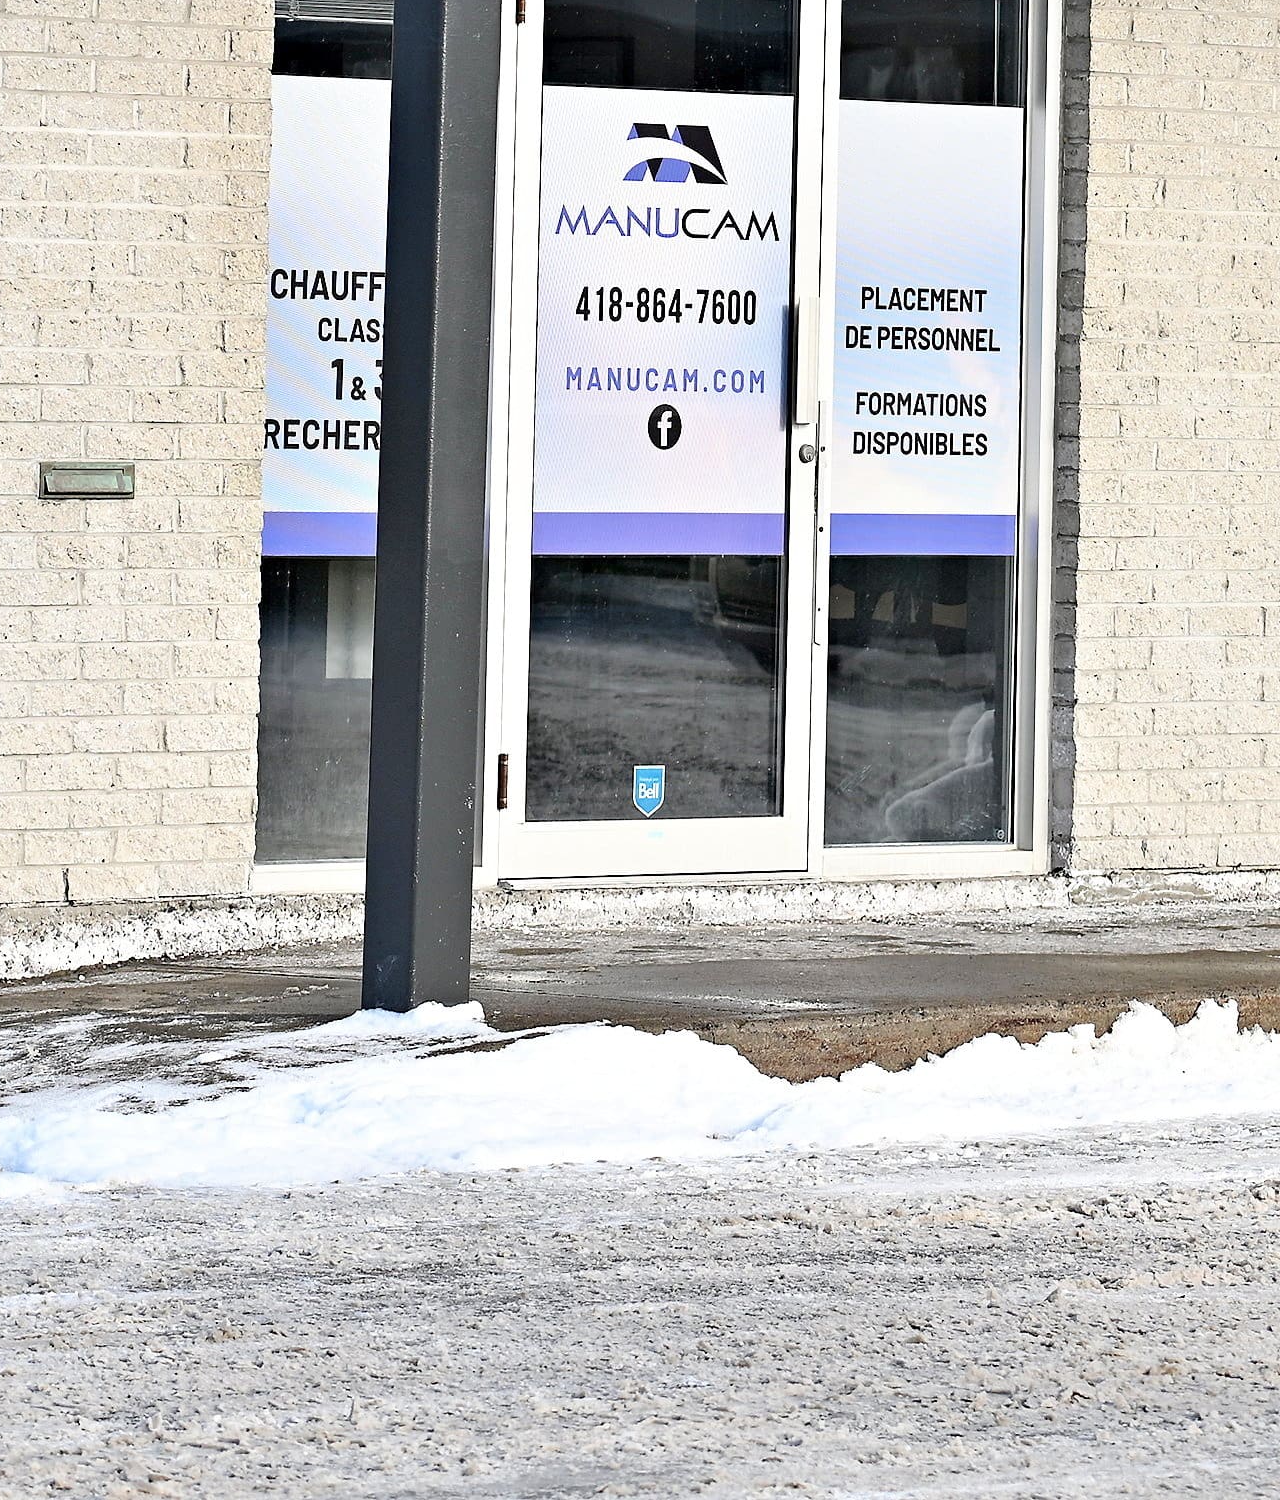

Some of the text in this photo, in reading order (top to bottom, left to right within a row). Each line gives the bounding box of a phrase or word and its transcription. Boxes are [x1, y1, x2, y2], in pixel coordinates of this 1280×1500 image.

[555, 204, 780, 241] MANUCAM
[270, 269, 386, 301] CHAUFF
[576, 286, 757, 325] 418-864-7600
[861, 286, 988, 313] PLACEMENT
[318, 317, 384, 343] CLAS
[845, 325, 1001, 352] DE PERSONNEL
[331, 358, 345, 401] 1
[350, 376, 367, 401] &
[566, 366, 765, 394] MANUCAM.COM
[855, 391, 987, 417] FORMATIONS
[264, 418, 381, 451] RECHER
[852, 431, 988, 457] DISPONIBLES
[638, 782, 660, 799] Bell
